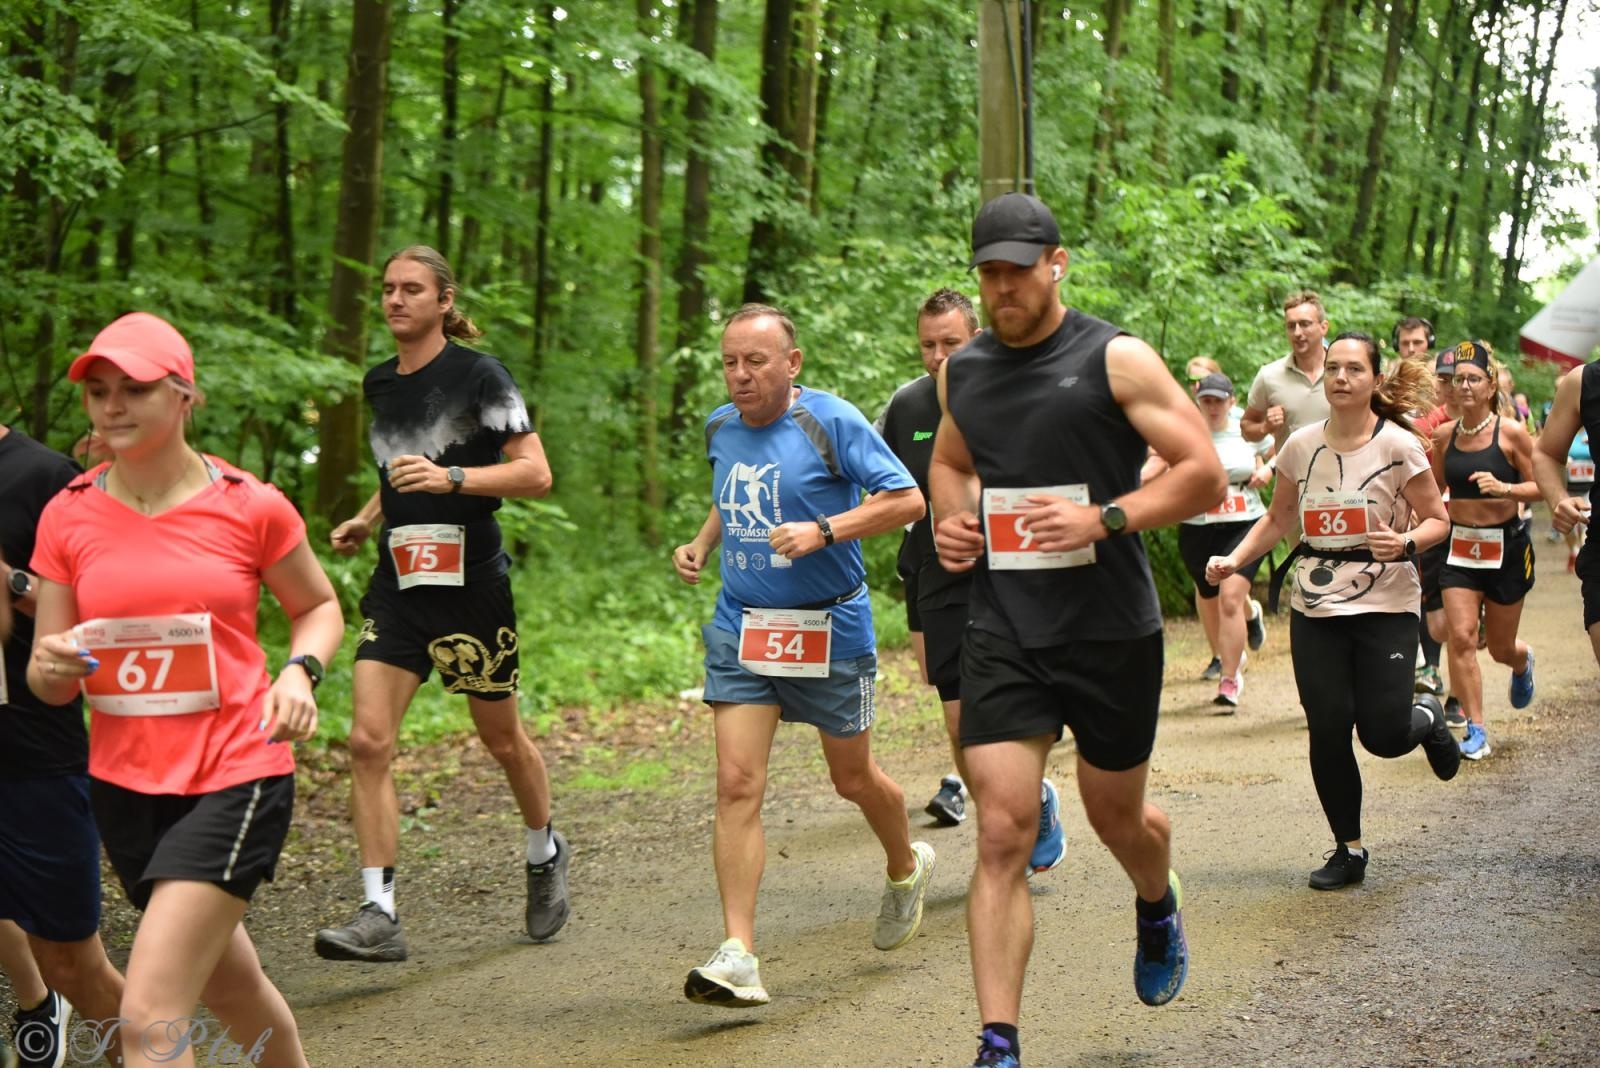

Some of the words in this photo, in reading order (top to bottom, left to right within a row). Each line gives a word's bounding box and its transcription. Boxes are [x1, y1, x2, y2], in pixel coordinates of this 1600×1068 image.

[1319, 511, 1347, 534] 36
[405, 545, 439, 571] 75
[1470, 542, 1482, 560] 4
[168, 627, 192, 637] 4500
[764, 632, 805, 660] 54
[117, 648, 175, 692] 67
